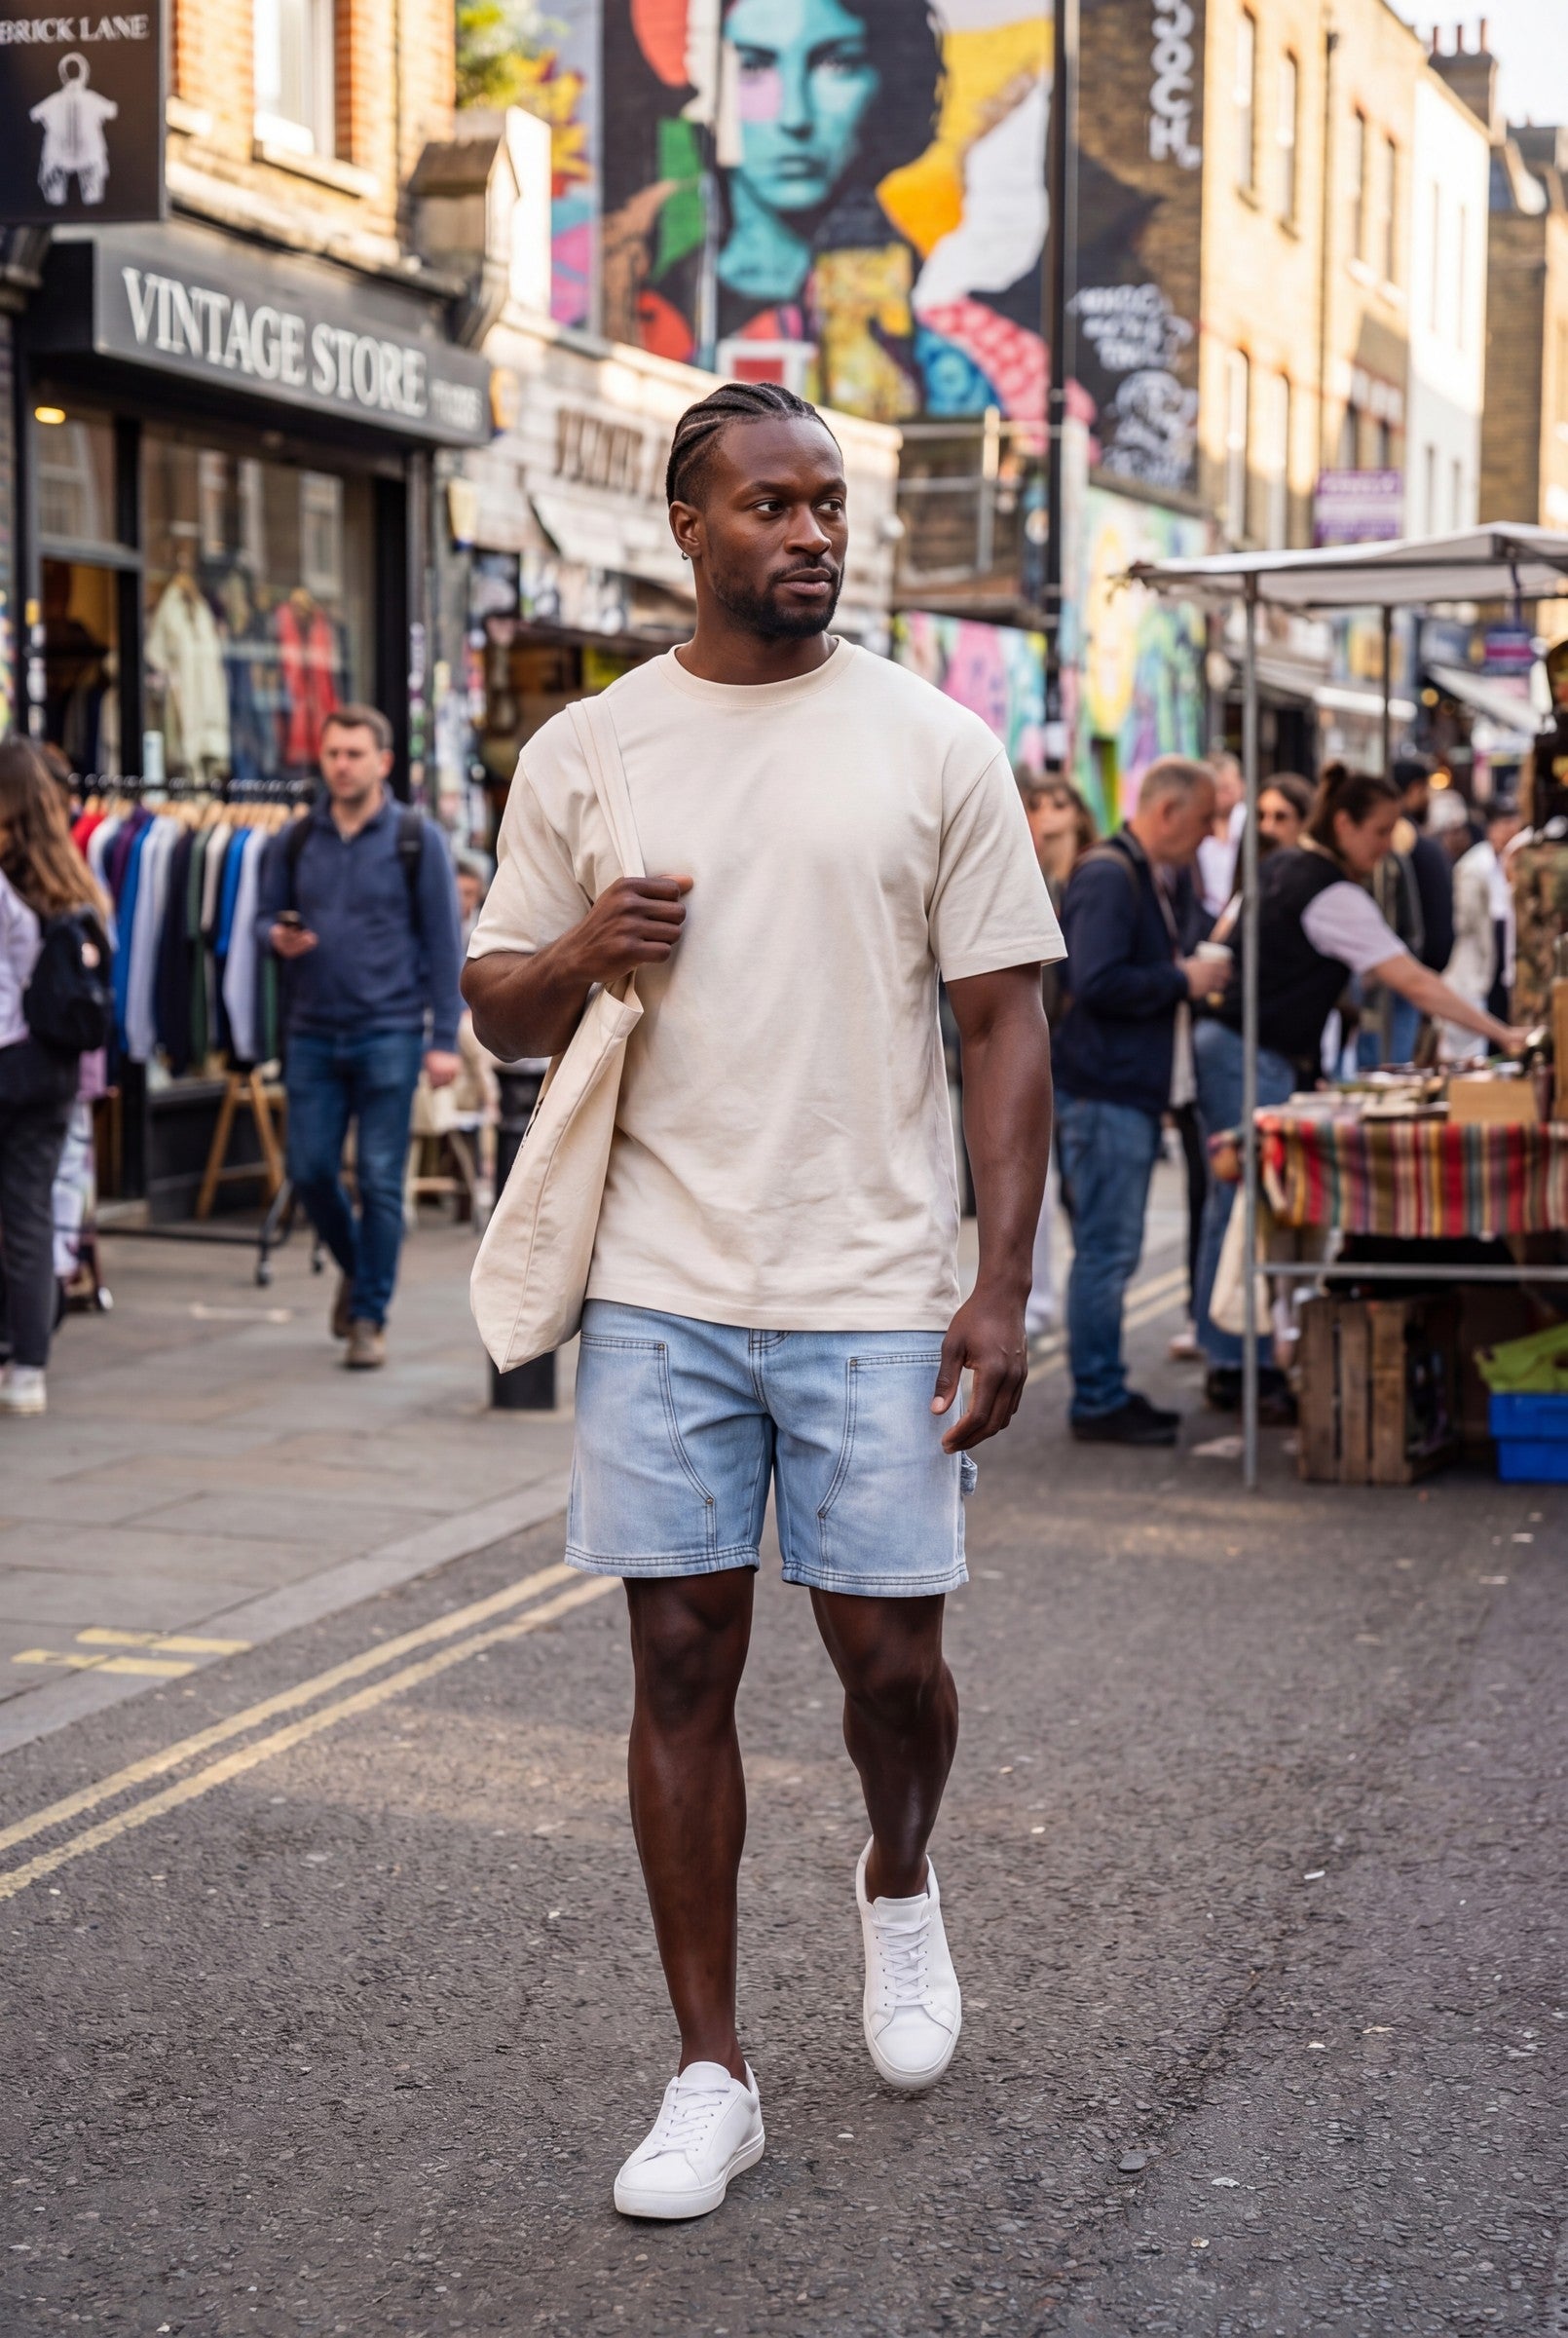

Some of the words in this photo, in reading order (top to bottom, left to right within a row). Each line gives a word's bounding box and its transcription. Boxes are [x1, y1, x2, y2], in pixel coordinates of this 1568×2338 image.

[0, 19, 76, 45] BRICK
[80, 14, 150, 41] LANE
[122, 266, 307, 387] VINTAGE
[311, 322, 427, 418] STORE
